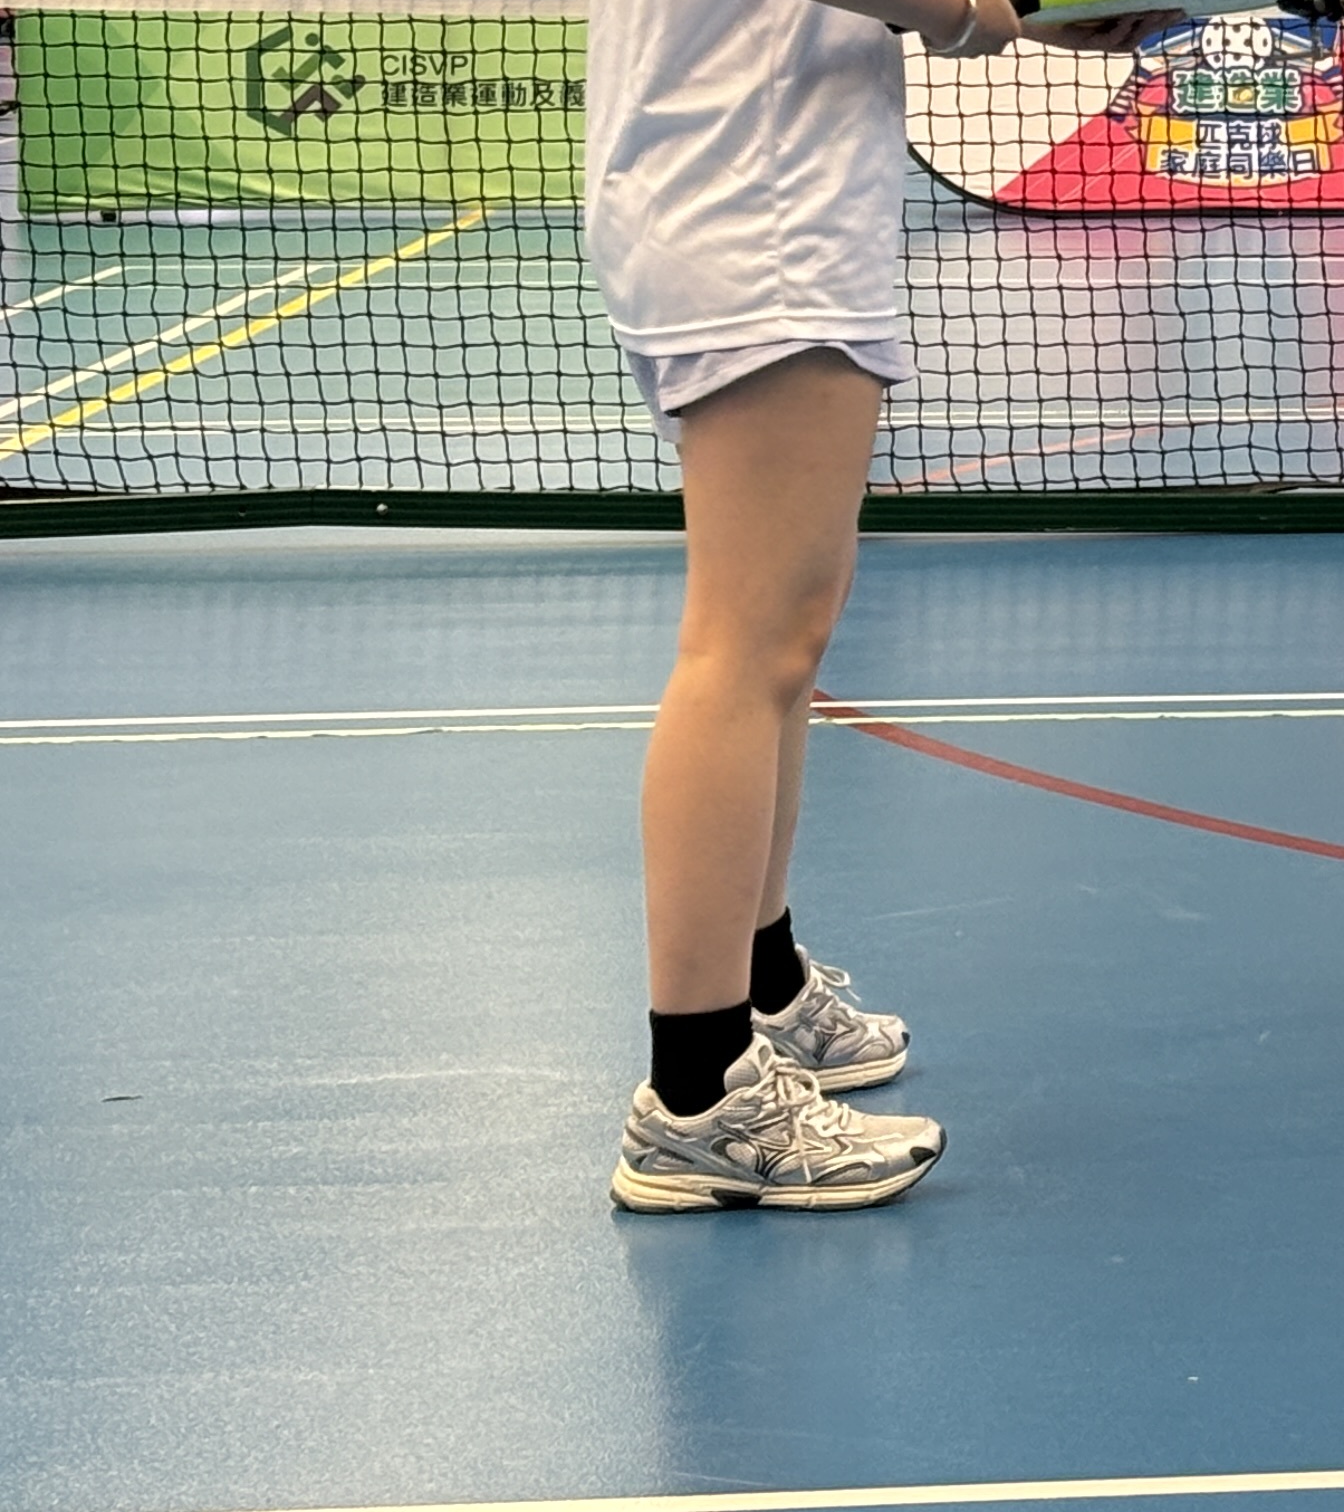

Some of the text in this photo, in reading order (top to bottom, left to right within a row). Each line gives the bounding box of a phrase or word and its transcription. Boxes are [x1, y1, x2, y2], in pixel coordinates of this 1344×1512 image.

[383, 54, 469, 77] CISVP
[1172, 68, 1303, 114] 建造業
